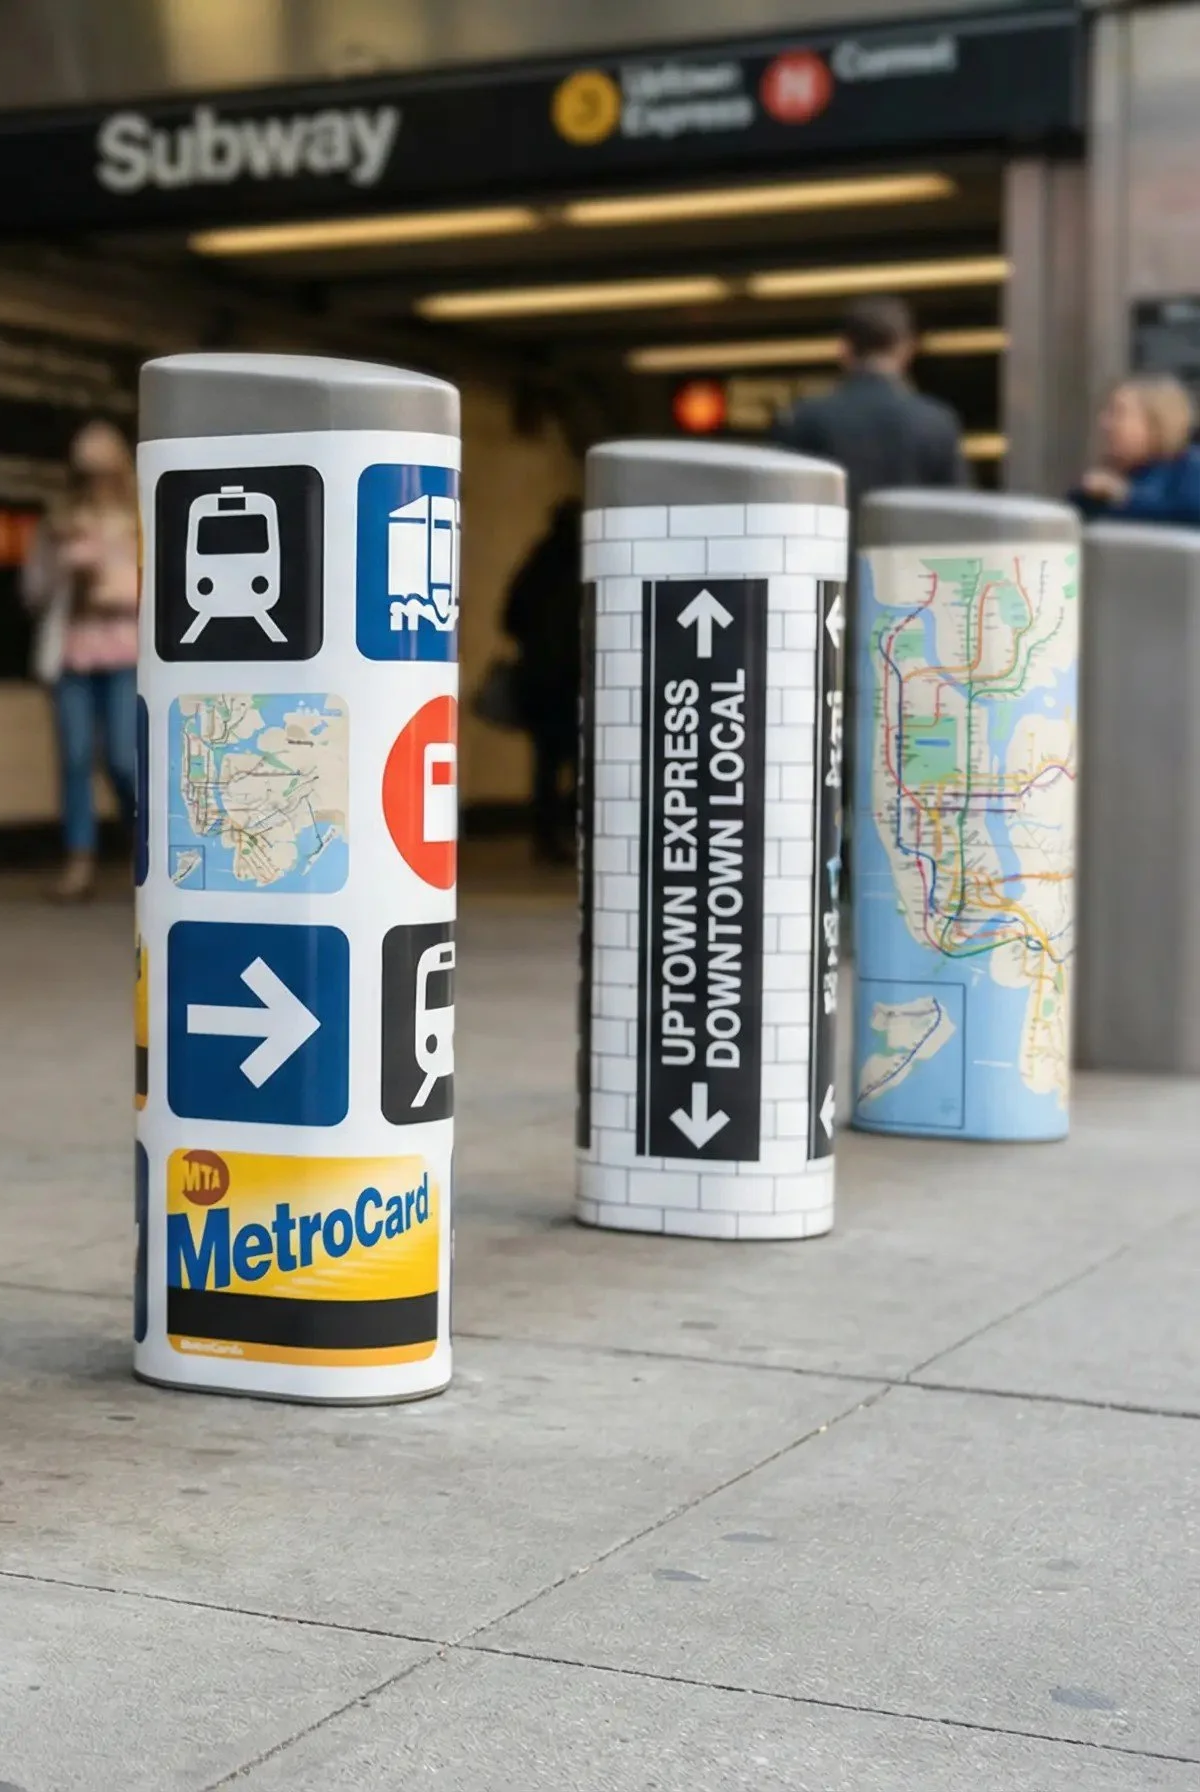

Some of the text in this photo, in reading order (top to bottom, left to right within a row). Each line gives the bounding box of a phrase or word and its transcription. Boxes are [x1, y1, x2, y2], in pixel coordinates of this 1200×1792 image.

[97, 105, 398, 191] Subway
[661, 678, 700, 1067] UPTOWN EXPRESS
[706, 668, 746, 1069] DOWNTOWN LOCAL
[166, 1171, 429, 1291] MetroCard
[182, 1158, 220, 1192] MTA
